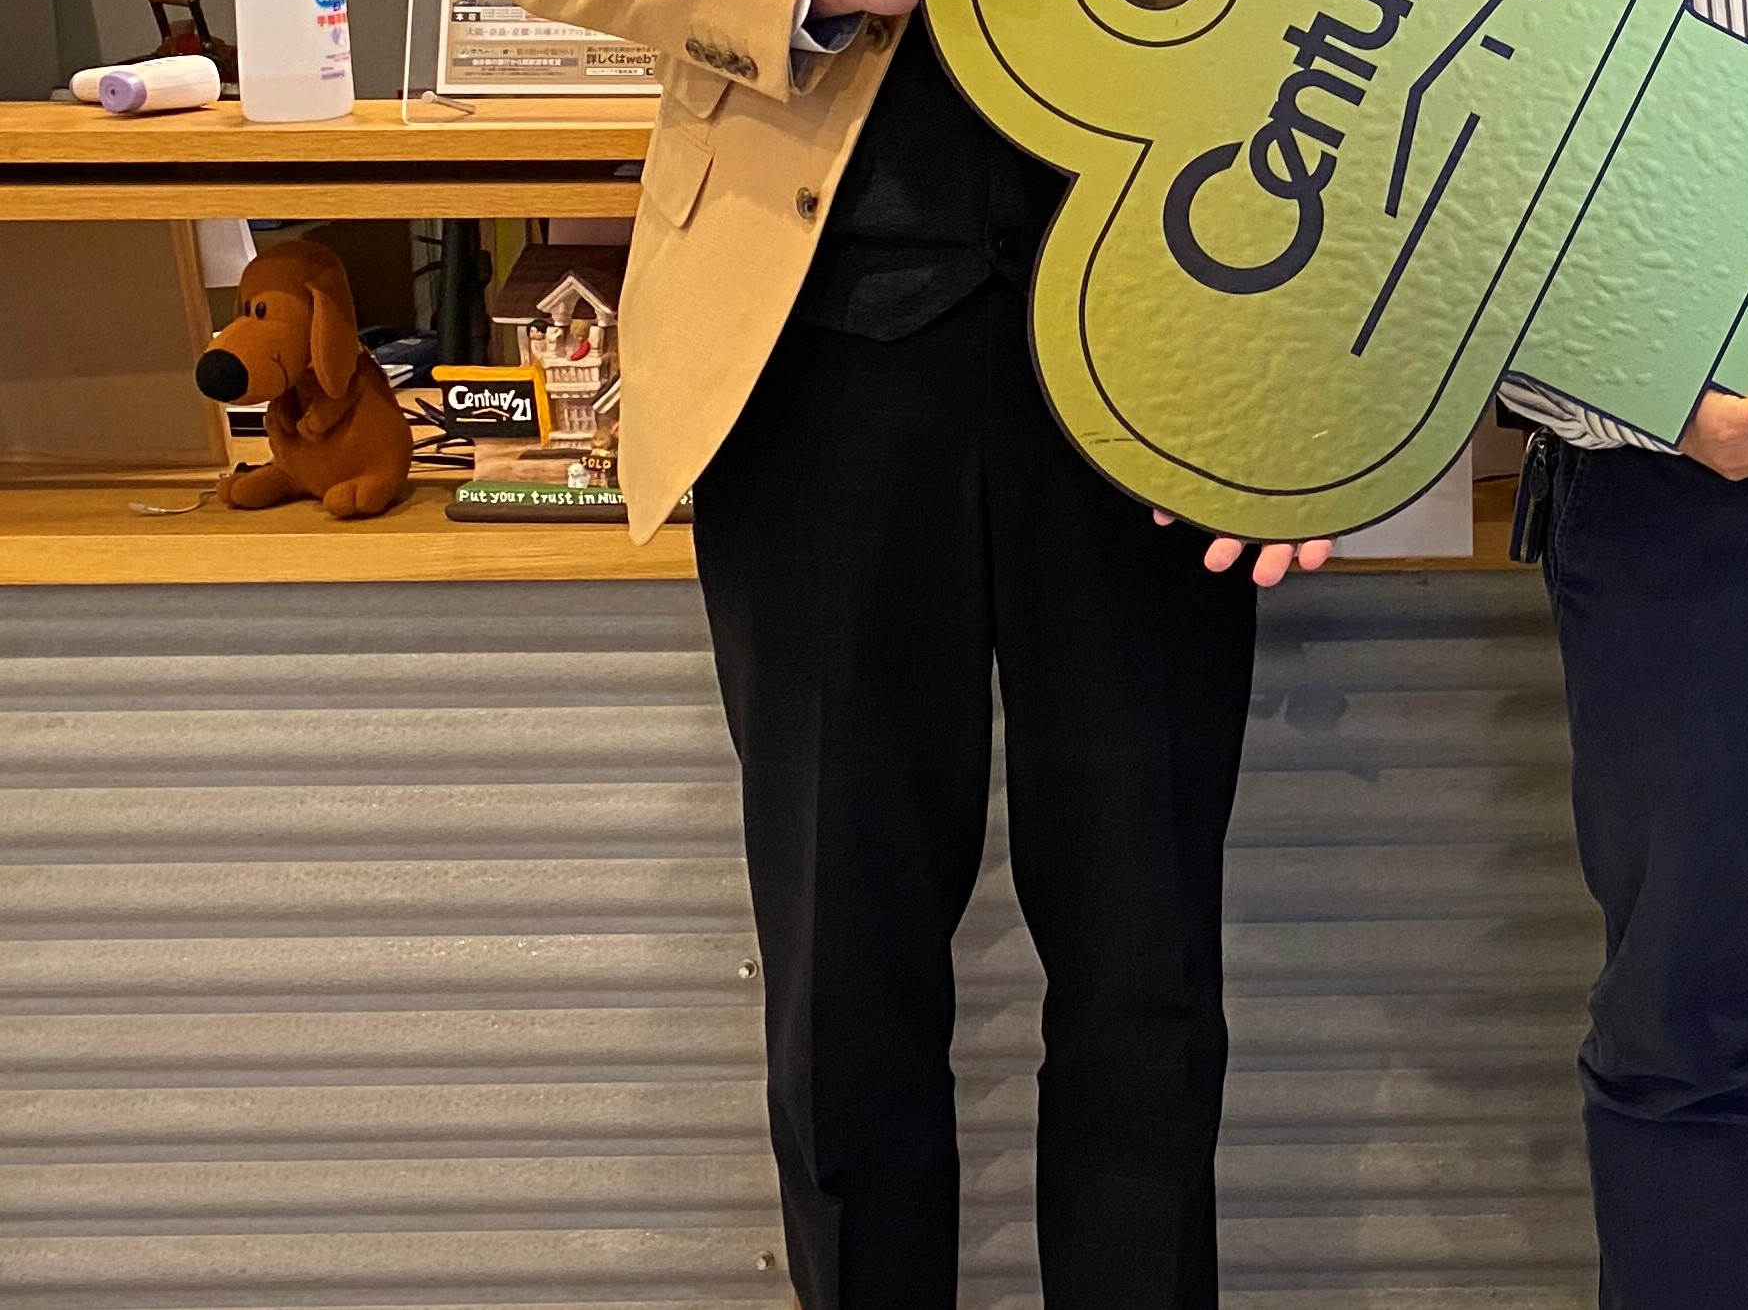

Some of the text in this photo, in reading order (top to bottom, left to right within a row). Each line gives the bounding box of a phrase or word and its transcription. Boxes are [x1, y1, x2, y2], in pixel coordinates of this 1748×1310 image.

[447, 385, 532, 422] Century 21
[580, 455, 612, 470] SOLD
[458, 489, 487, 503] Put
[489, 491, 525, 504] your
[531, 491, 574, 505] trust
[579, 490, 595, 504] in
